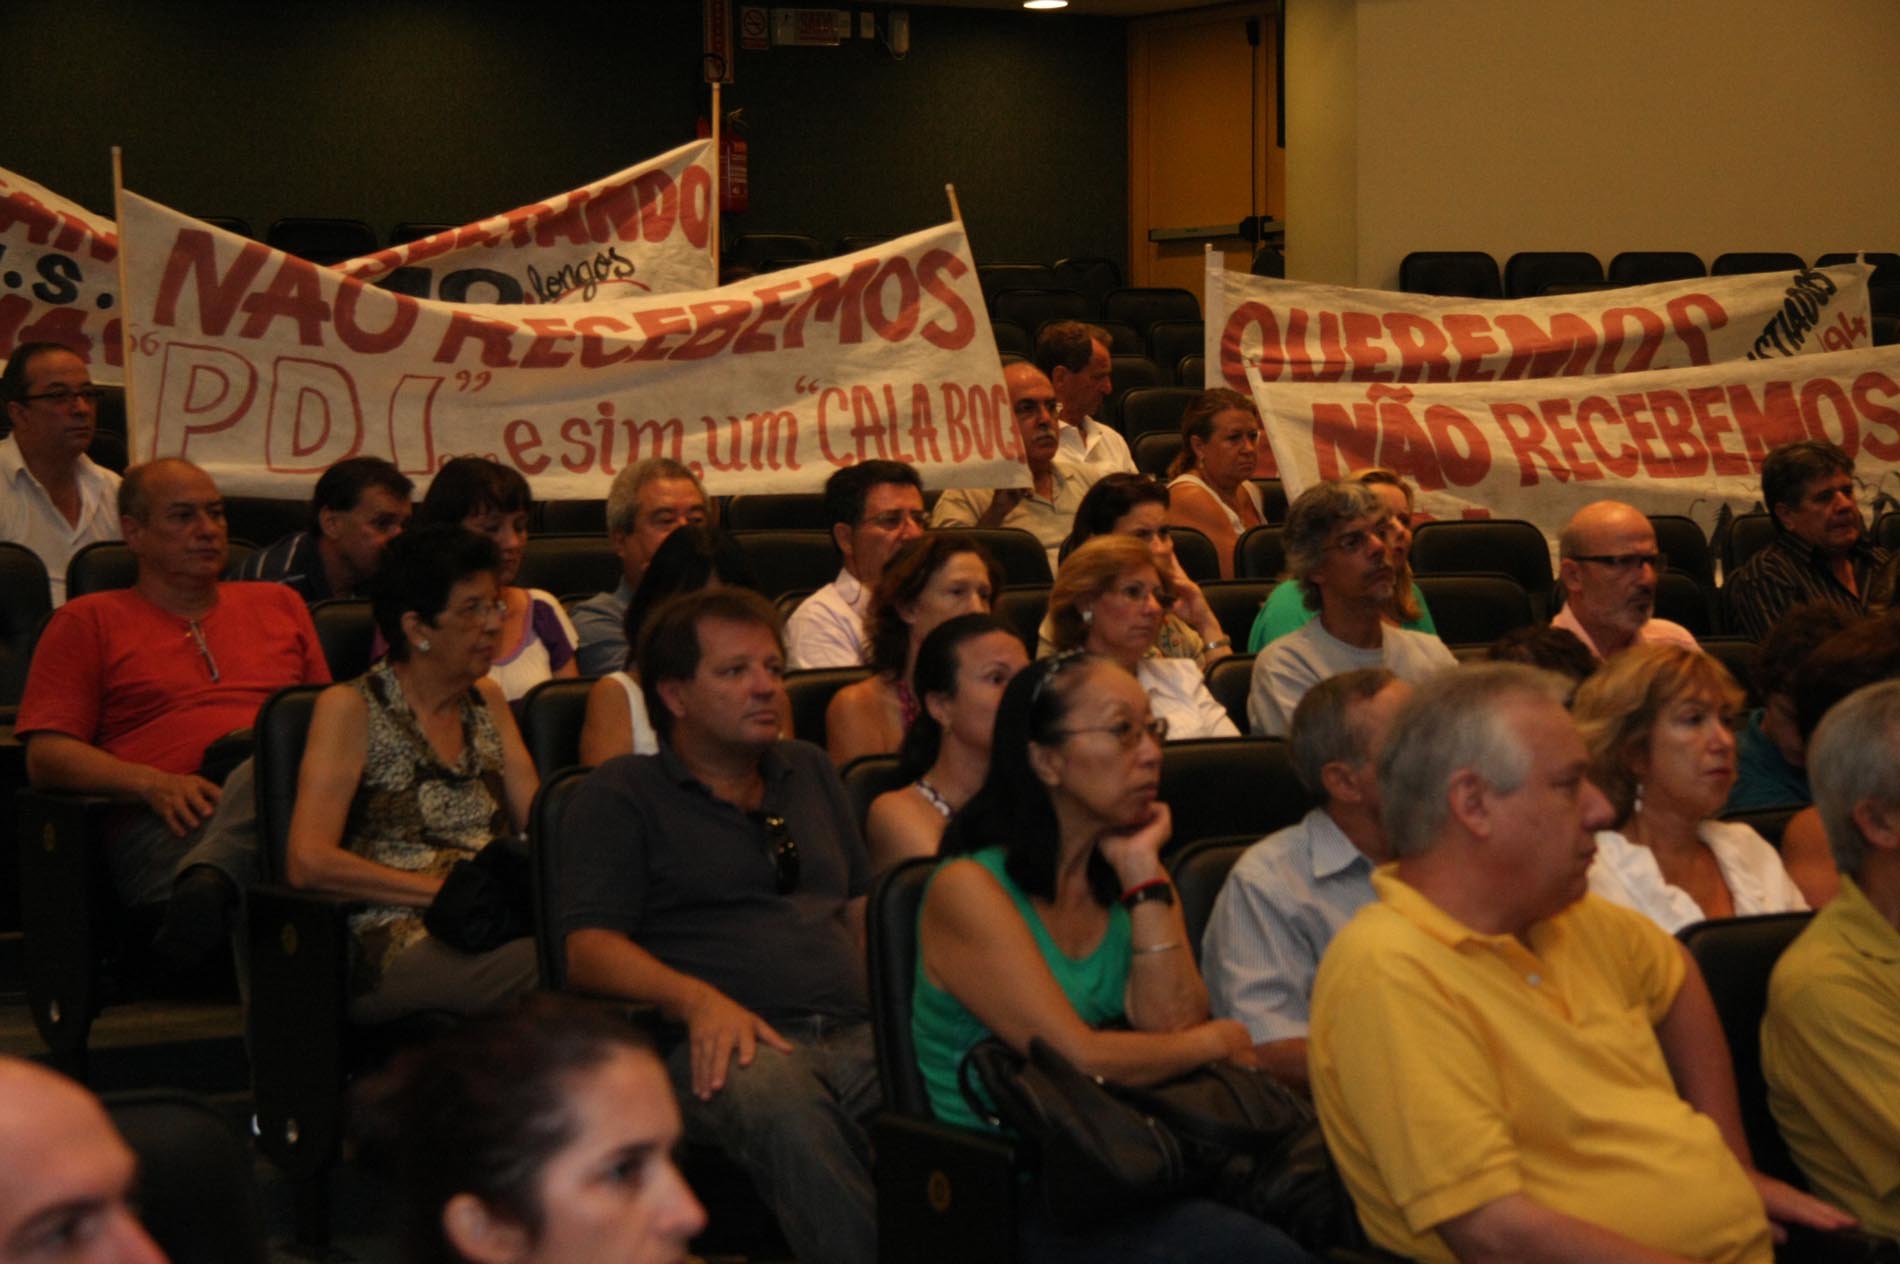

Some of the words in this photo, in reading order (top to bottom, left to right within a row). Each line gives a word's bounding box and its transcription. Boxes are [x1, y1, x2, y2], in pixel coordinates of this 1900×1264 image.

[434, 249, 976, 369] RECEBEMOS
[503, 419, 556, 477] e
[700, 411, 802, 473] um
[1312, 384, 1492, 491] NÃO
[1490, 371, 1900, 487] RECEBEMOS
